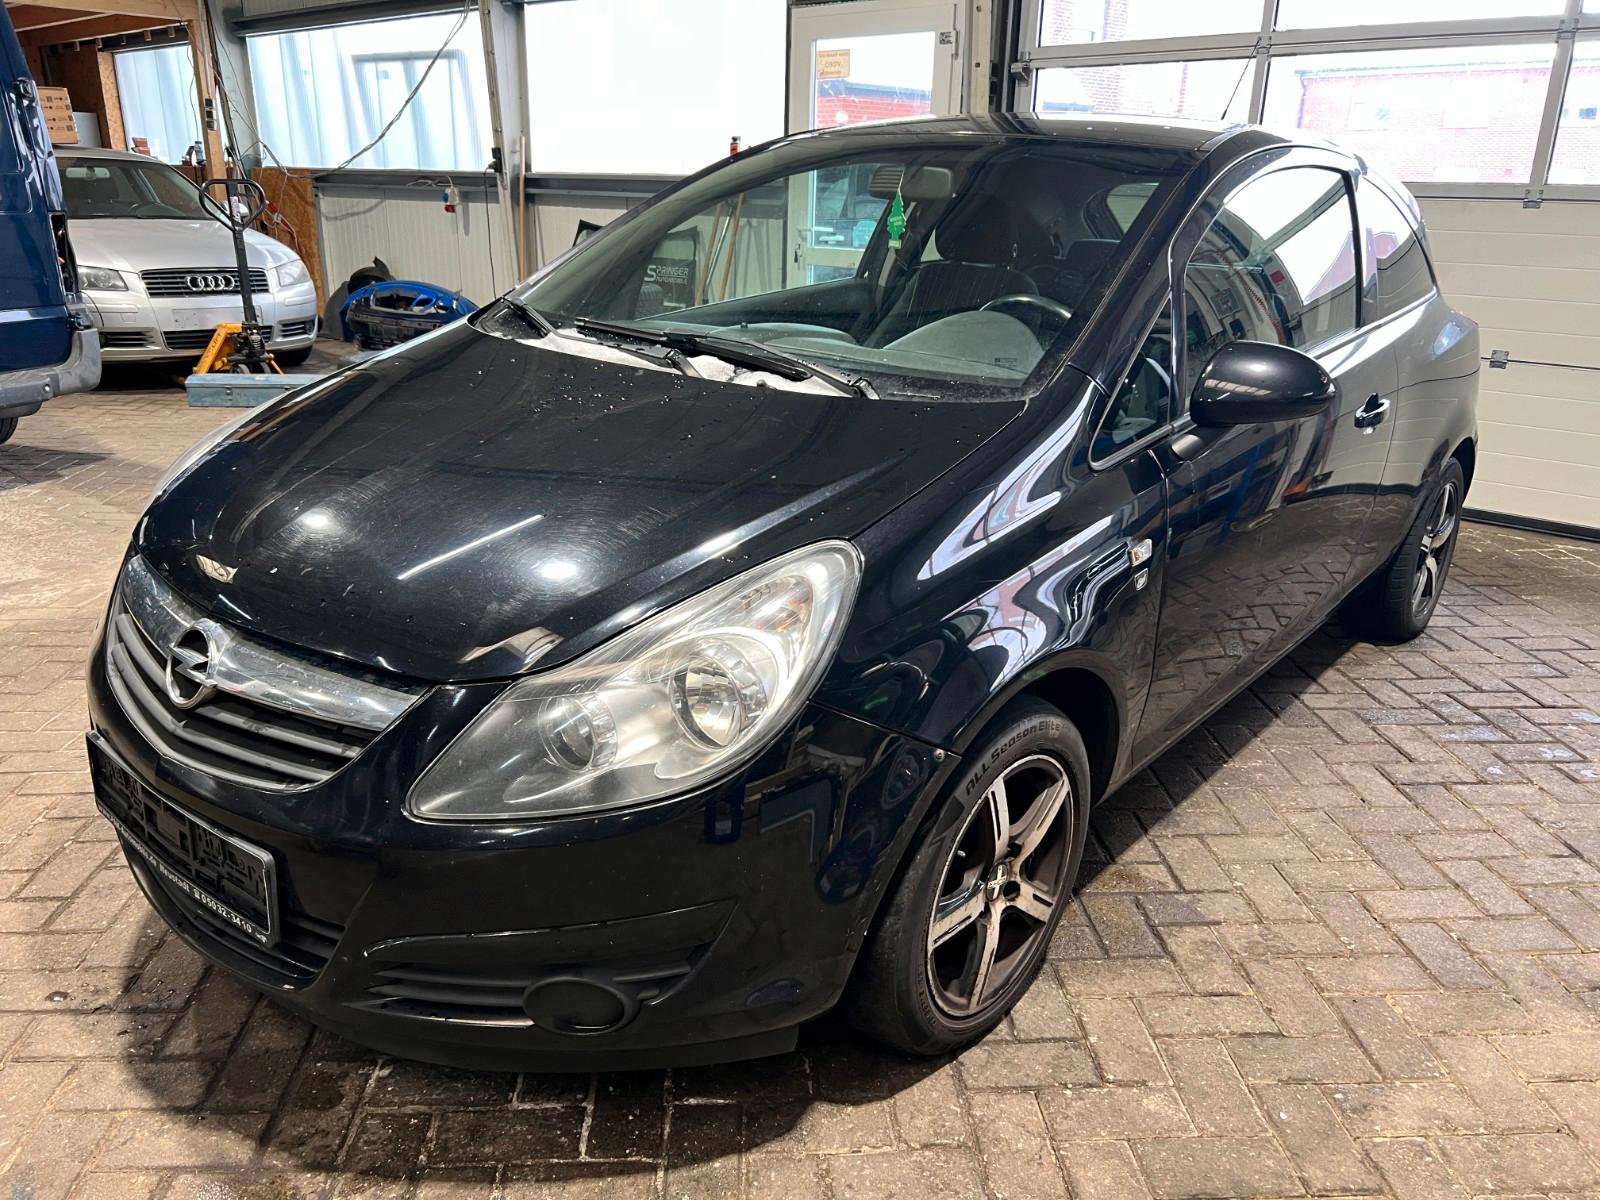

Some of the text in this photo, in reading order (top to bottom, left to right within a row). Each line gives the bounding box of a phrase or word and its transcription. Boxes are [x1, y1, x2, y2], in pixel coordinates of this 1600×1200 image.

[966, 763, 990, 795] ALL
[991, 726, 1037, 763] Season
[201, 894, 252, 934] 05032-3410
